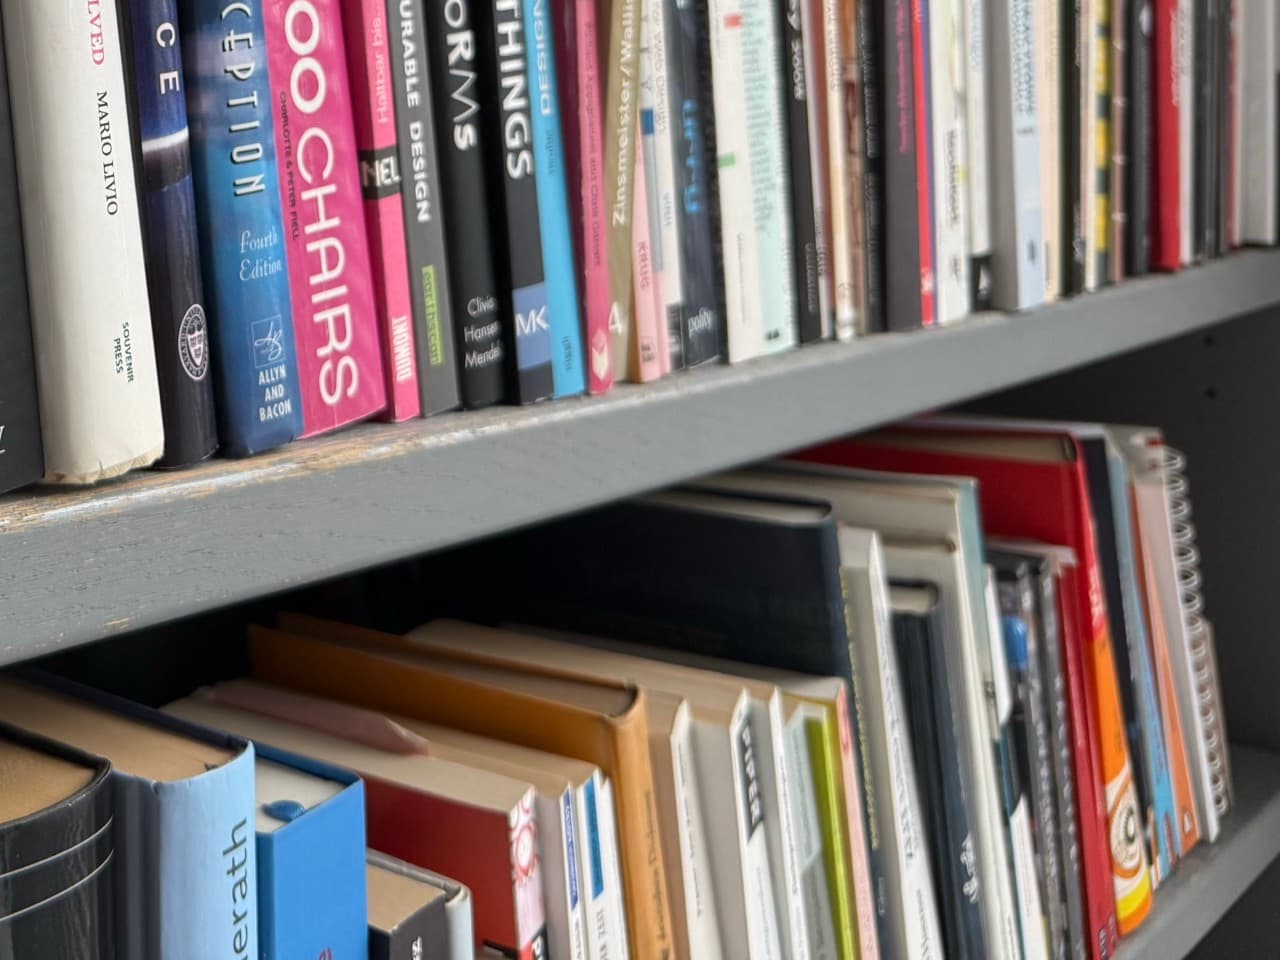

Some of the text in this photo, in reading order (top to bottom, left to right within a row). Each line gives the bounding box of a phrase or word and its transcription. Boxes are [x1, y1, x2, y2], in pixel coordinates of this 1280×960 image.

[374, 53, 388, 125] Haltbar
[654, 77, 667, 133] Design
[279, 91, 291, 158] CHARLOTTE
[95, 90, 119, 216] MARIO LIVIO
[287, 171, 296, 207] PETER
[409, 122, 432, 224] DESIGN
[240, 228, 279, 254] Fourth
[290, 211, 299, 240] FIELL
[240, 258, 282, 281] Edition
[296, 127, 360, 407] CHAIRS
[515, 305, 550, 336] MK
[608, 300, 623, 335] 4
[687, 306, 713, 338] polity
[114, 337, 124, 375] PRESS
[122, 321, 135, 384] SOUVENIR
[392, 316, 413, 382] DUMONT
[258, 364, 287, 385] ALLYN
[264, 384, 284, 402] AND
[259, 399, 292, 421] BACON
[742, 725, 761, 825] PIPER
[223, 818, 248, 960] erath
